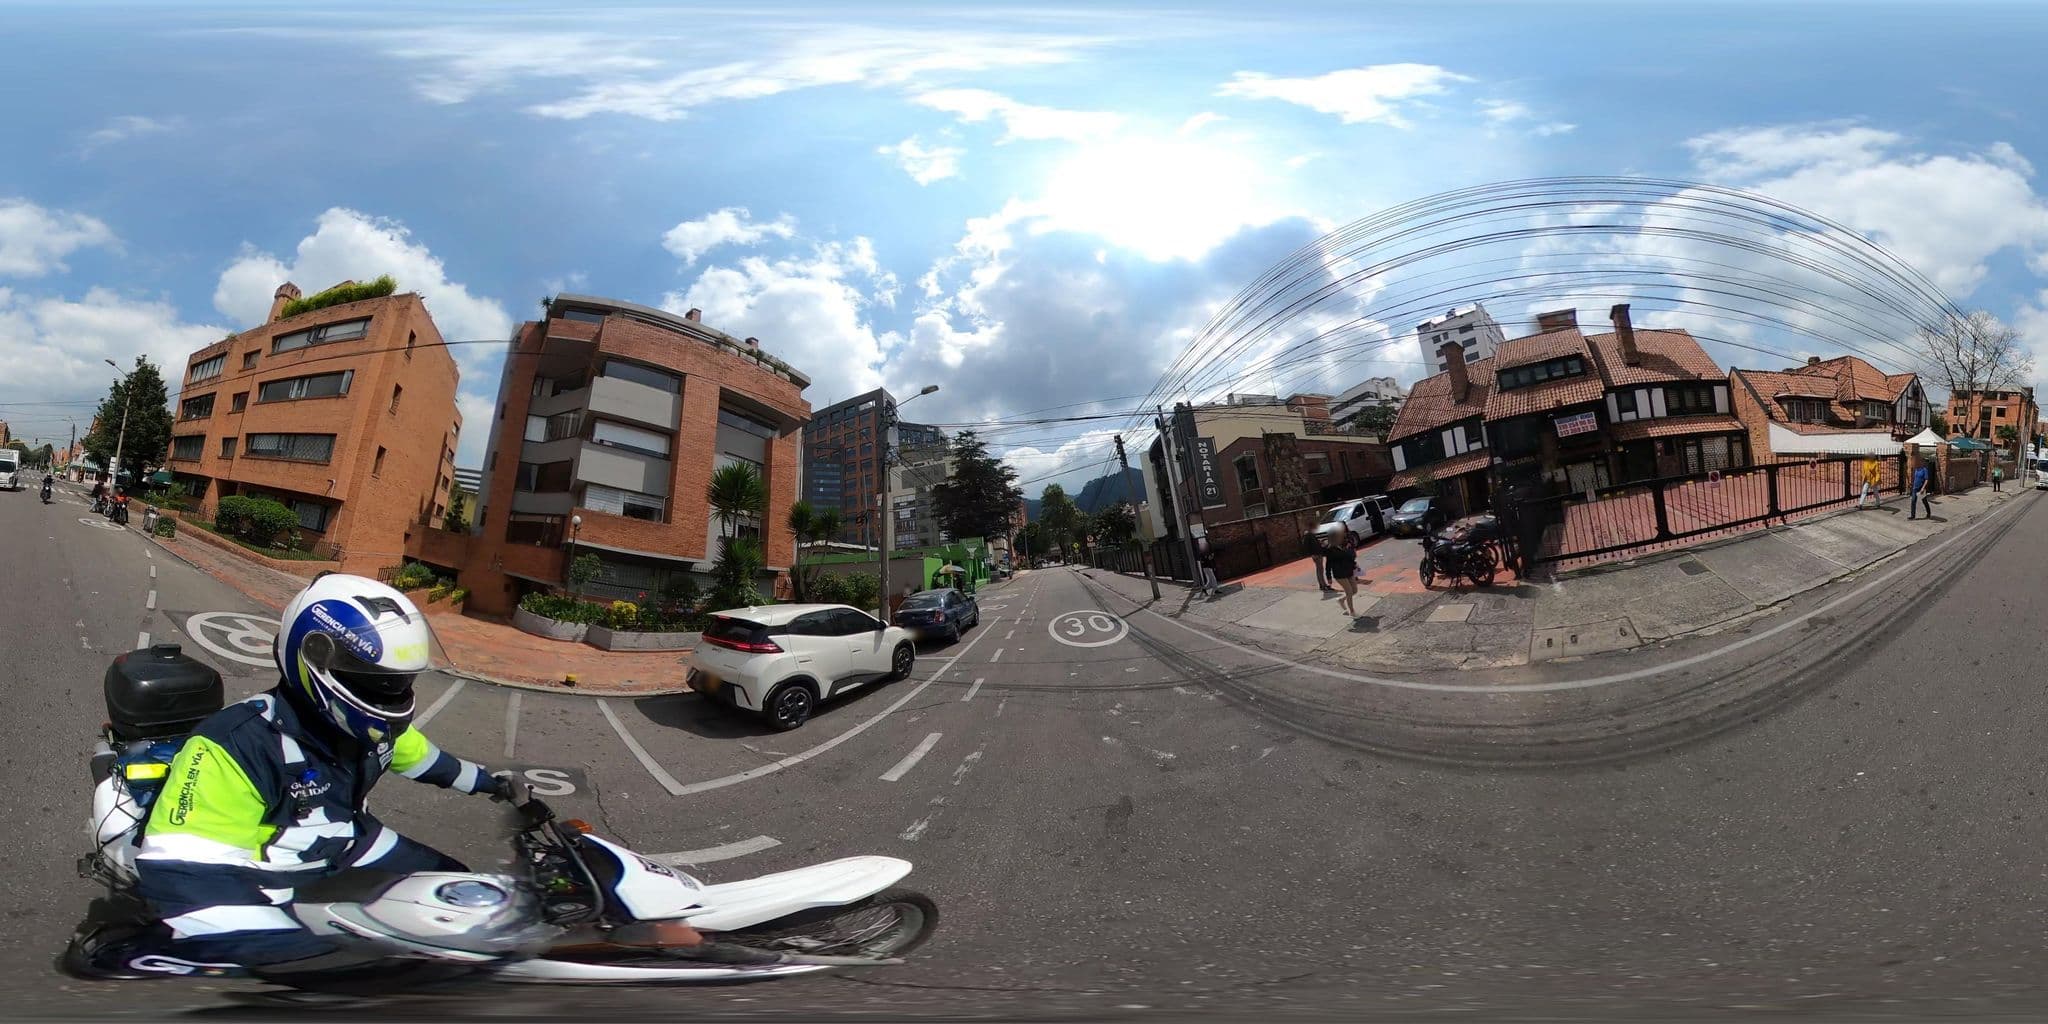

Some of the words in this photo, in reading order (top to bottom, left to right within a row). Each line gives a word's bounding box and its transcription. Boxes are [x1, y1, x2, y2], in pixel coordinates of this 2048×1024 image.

[1197, 442, 1214, 484] NOTARIA
[1206, 487, 1217, 495] 21
[311, 603, 345, 634] GERENCIA
[1063, 615, 1115, 636] 30
[169, 782, 192, 826] GERENCIA
[187, 767, 196, 780] EN
